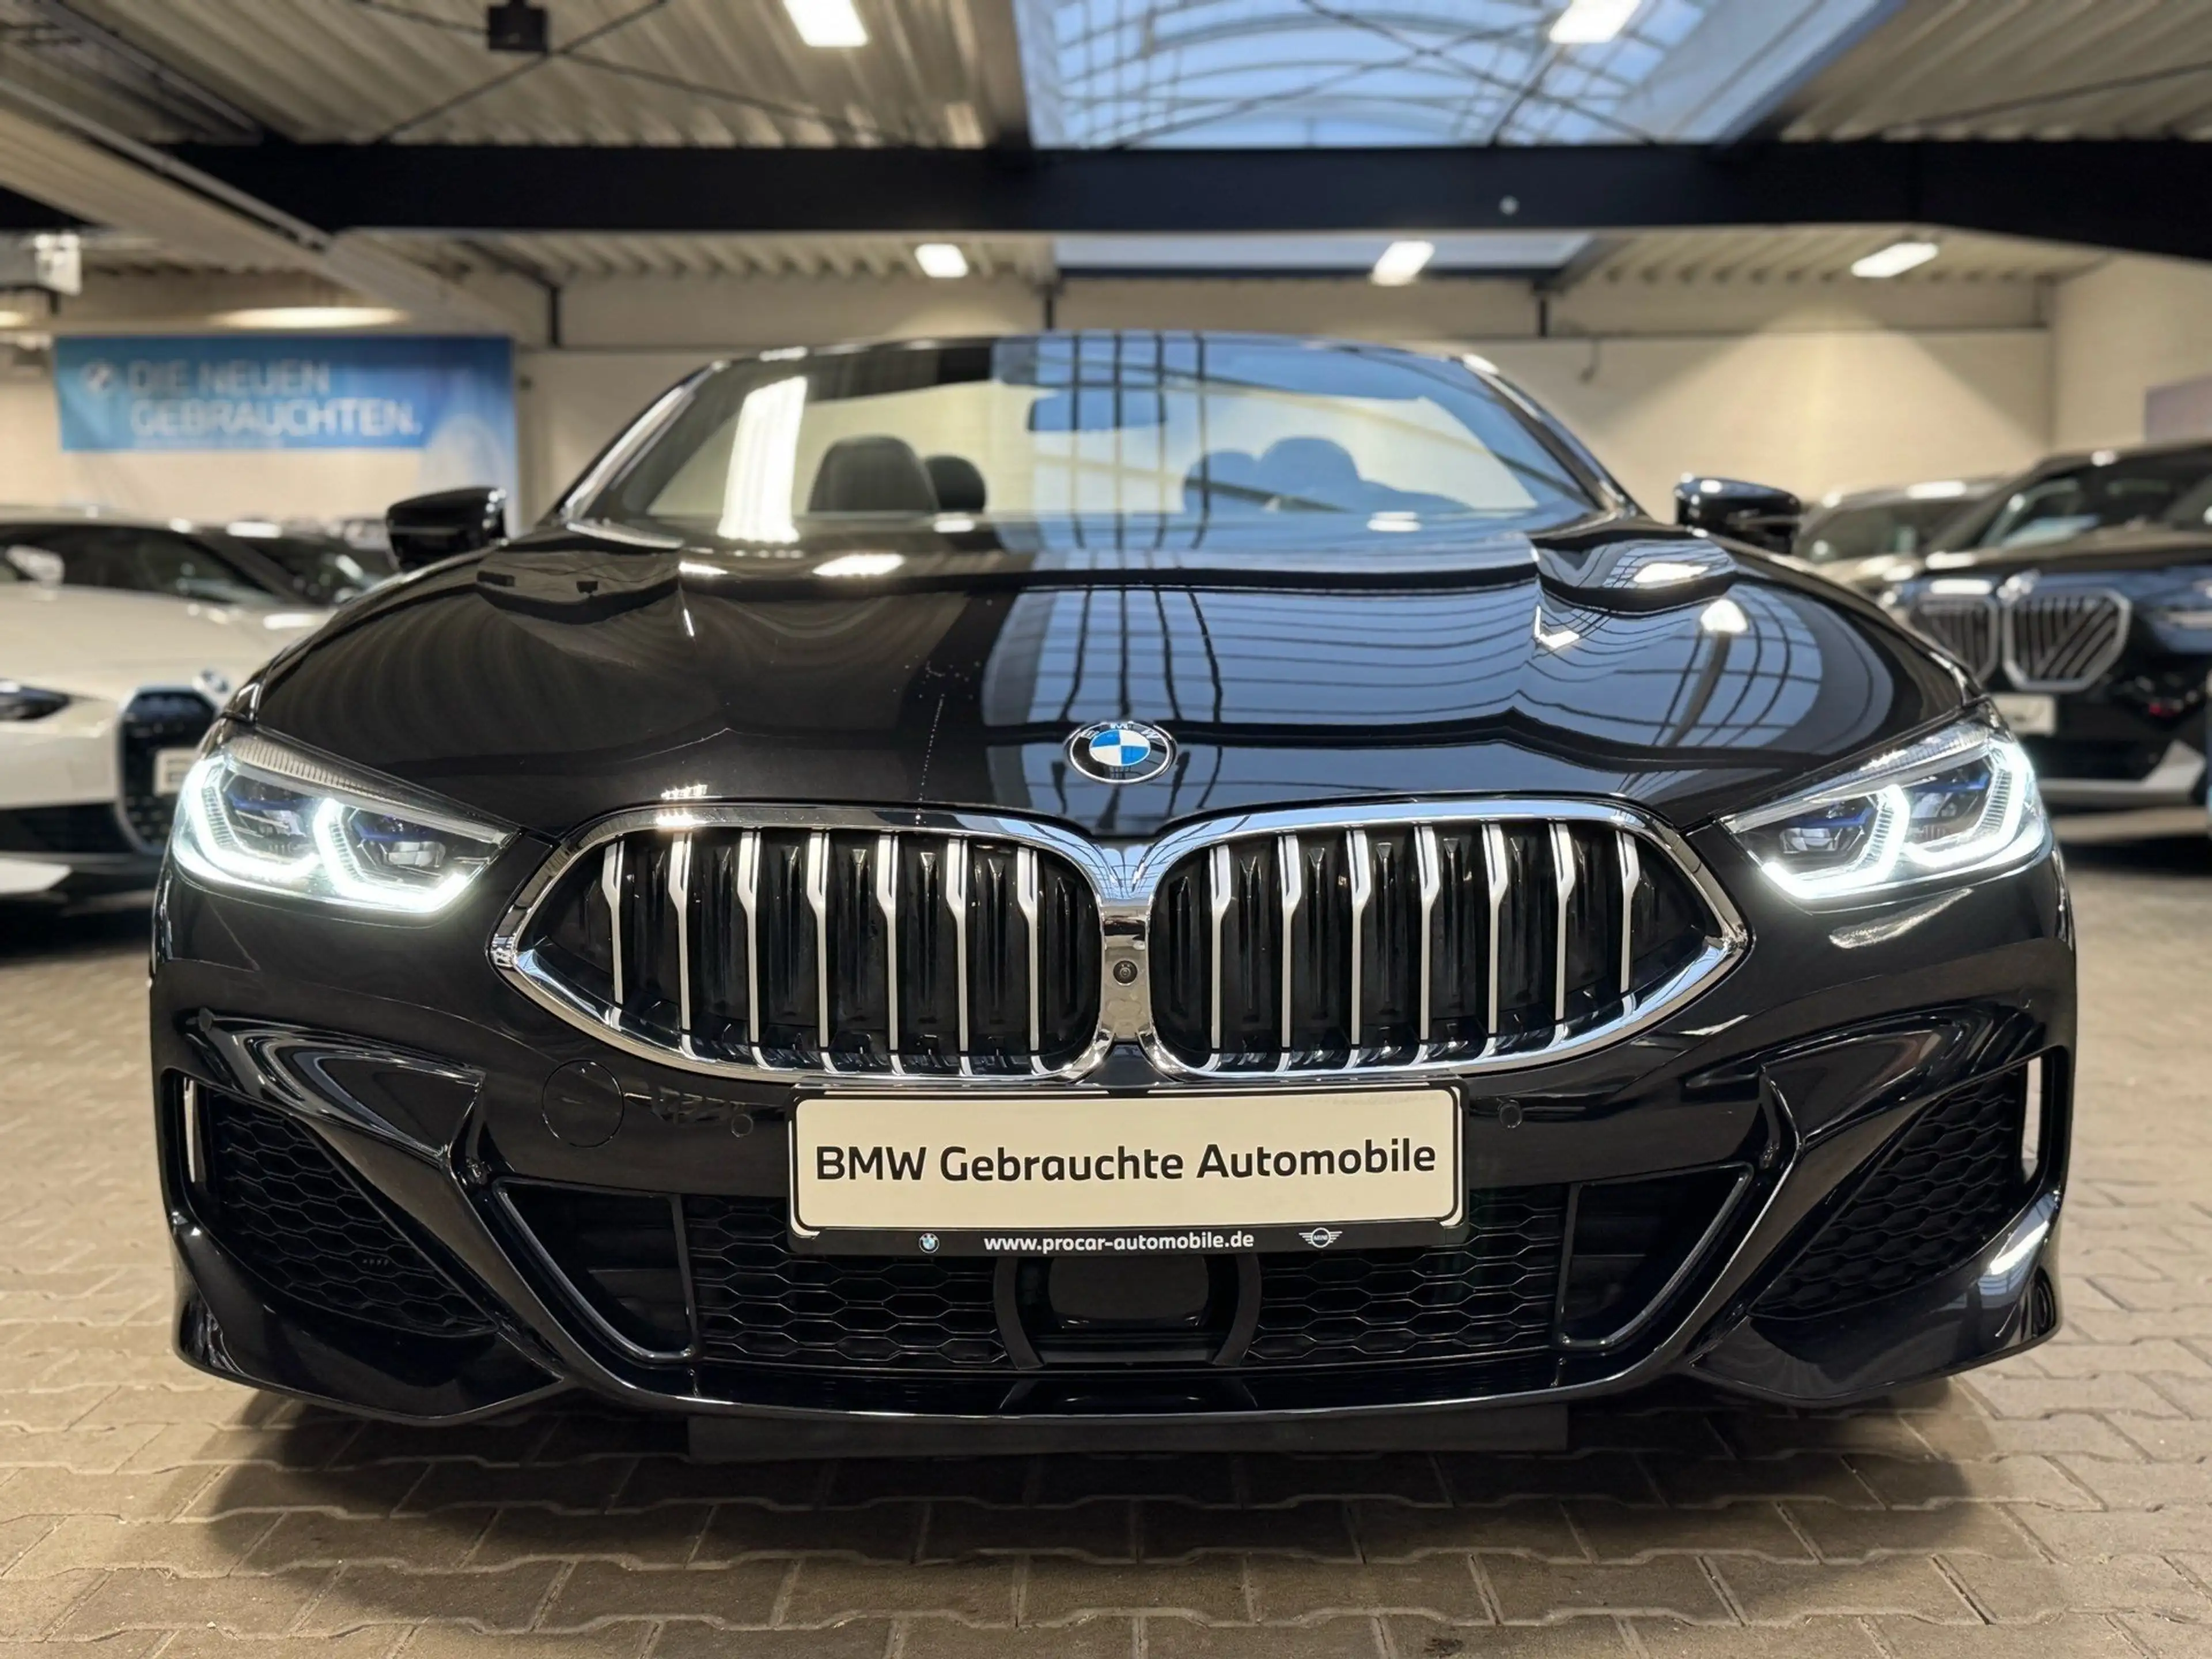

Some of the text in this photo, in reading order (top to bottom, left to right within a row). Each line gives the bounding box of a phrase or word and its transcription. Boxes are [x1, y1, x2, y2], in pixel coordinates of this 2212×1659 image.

[199, 359, 330, 396] NEUEN
[817, 1137, 1435, 1181] BMW Gebrauchte Automobile
[984, 1230, 1255, 1254] www.procar-automobile.de
